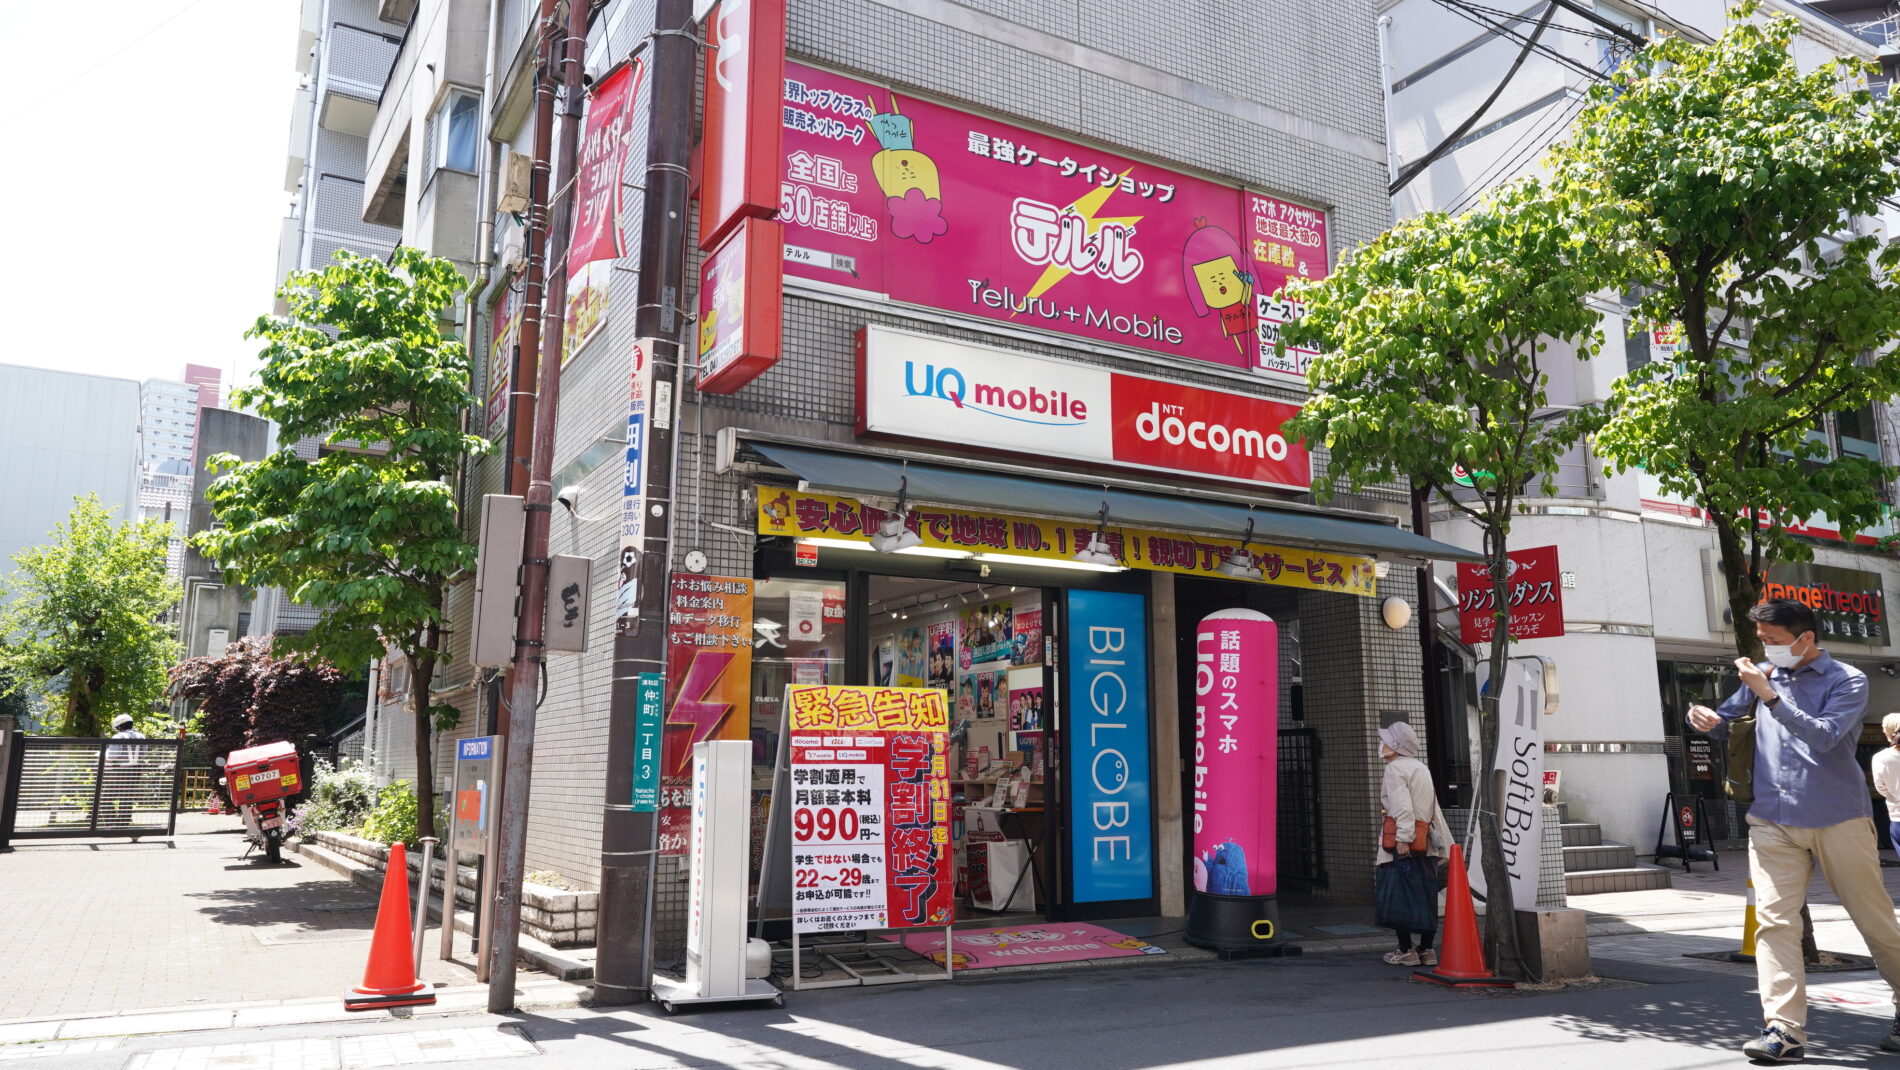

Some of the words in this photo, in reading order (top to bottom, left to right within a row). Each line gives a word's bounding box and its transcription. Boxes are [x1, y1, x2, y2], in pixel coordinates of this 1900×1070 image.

[783, 79, 873, 120] 界トップクラスの
[783, 106, 864, 145] 販売ネットワーク
[788, 150, 858, 193] 全国に
[968, 130, 1175, 202] 最強ケータイショップ
[781, 182, 877, 241] 50店舗以上!
[1252, 197, 1276, 218] スマホ
[1279, 204, 1322, 229] アクセサリー
[1010, 197, 1144, 283] テルル
[1256, 215, 1320, 248] 地域最大級の
[786, 247, 810, 260] テルル
[835, 258, 853, 269] 検索
[1253, 239, 1294, 268] 在庫数
[1259, 299, 1292, 320] ケース
[1268, 359, 1296, 371] バッテリー
[904, 359, 966, 408] UQ
[974, 382, 1087, 421] mobile
[1162, 405, 1184, 416] NTT
[1135, 402, 1287, 461] docomo
[672, 579, 748, 595] ホお悩み相談
[676, 595, 724, 610] 料金案内
[1461, 580, 1555, 612] ソシアダンス
[824, 605, 846, 618] 取扱
[793, 686, 946, 730] 緊急告知
[1218, 630, 1241, 754] 話題のスマホ
[463, 742, 487, 756] INFORMATION
[1089, 625, 1131, 861] BIGLOBE
[255, 772, 276, 781] 0707
[794, 769, 865, 785] 学割適用で
[1194, 706, 1208, 834] mobile
[795, 789, 871, 805] 月額基本料
[794, 807, 859, 841] 990
[891, 735, 935, 921] 学割終了
[795, 853, 882, 865] 学生ではない場合でも
[988, 943, 1101, 957] welcome
